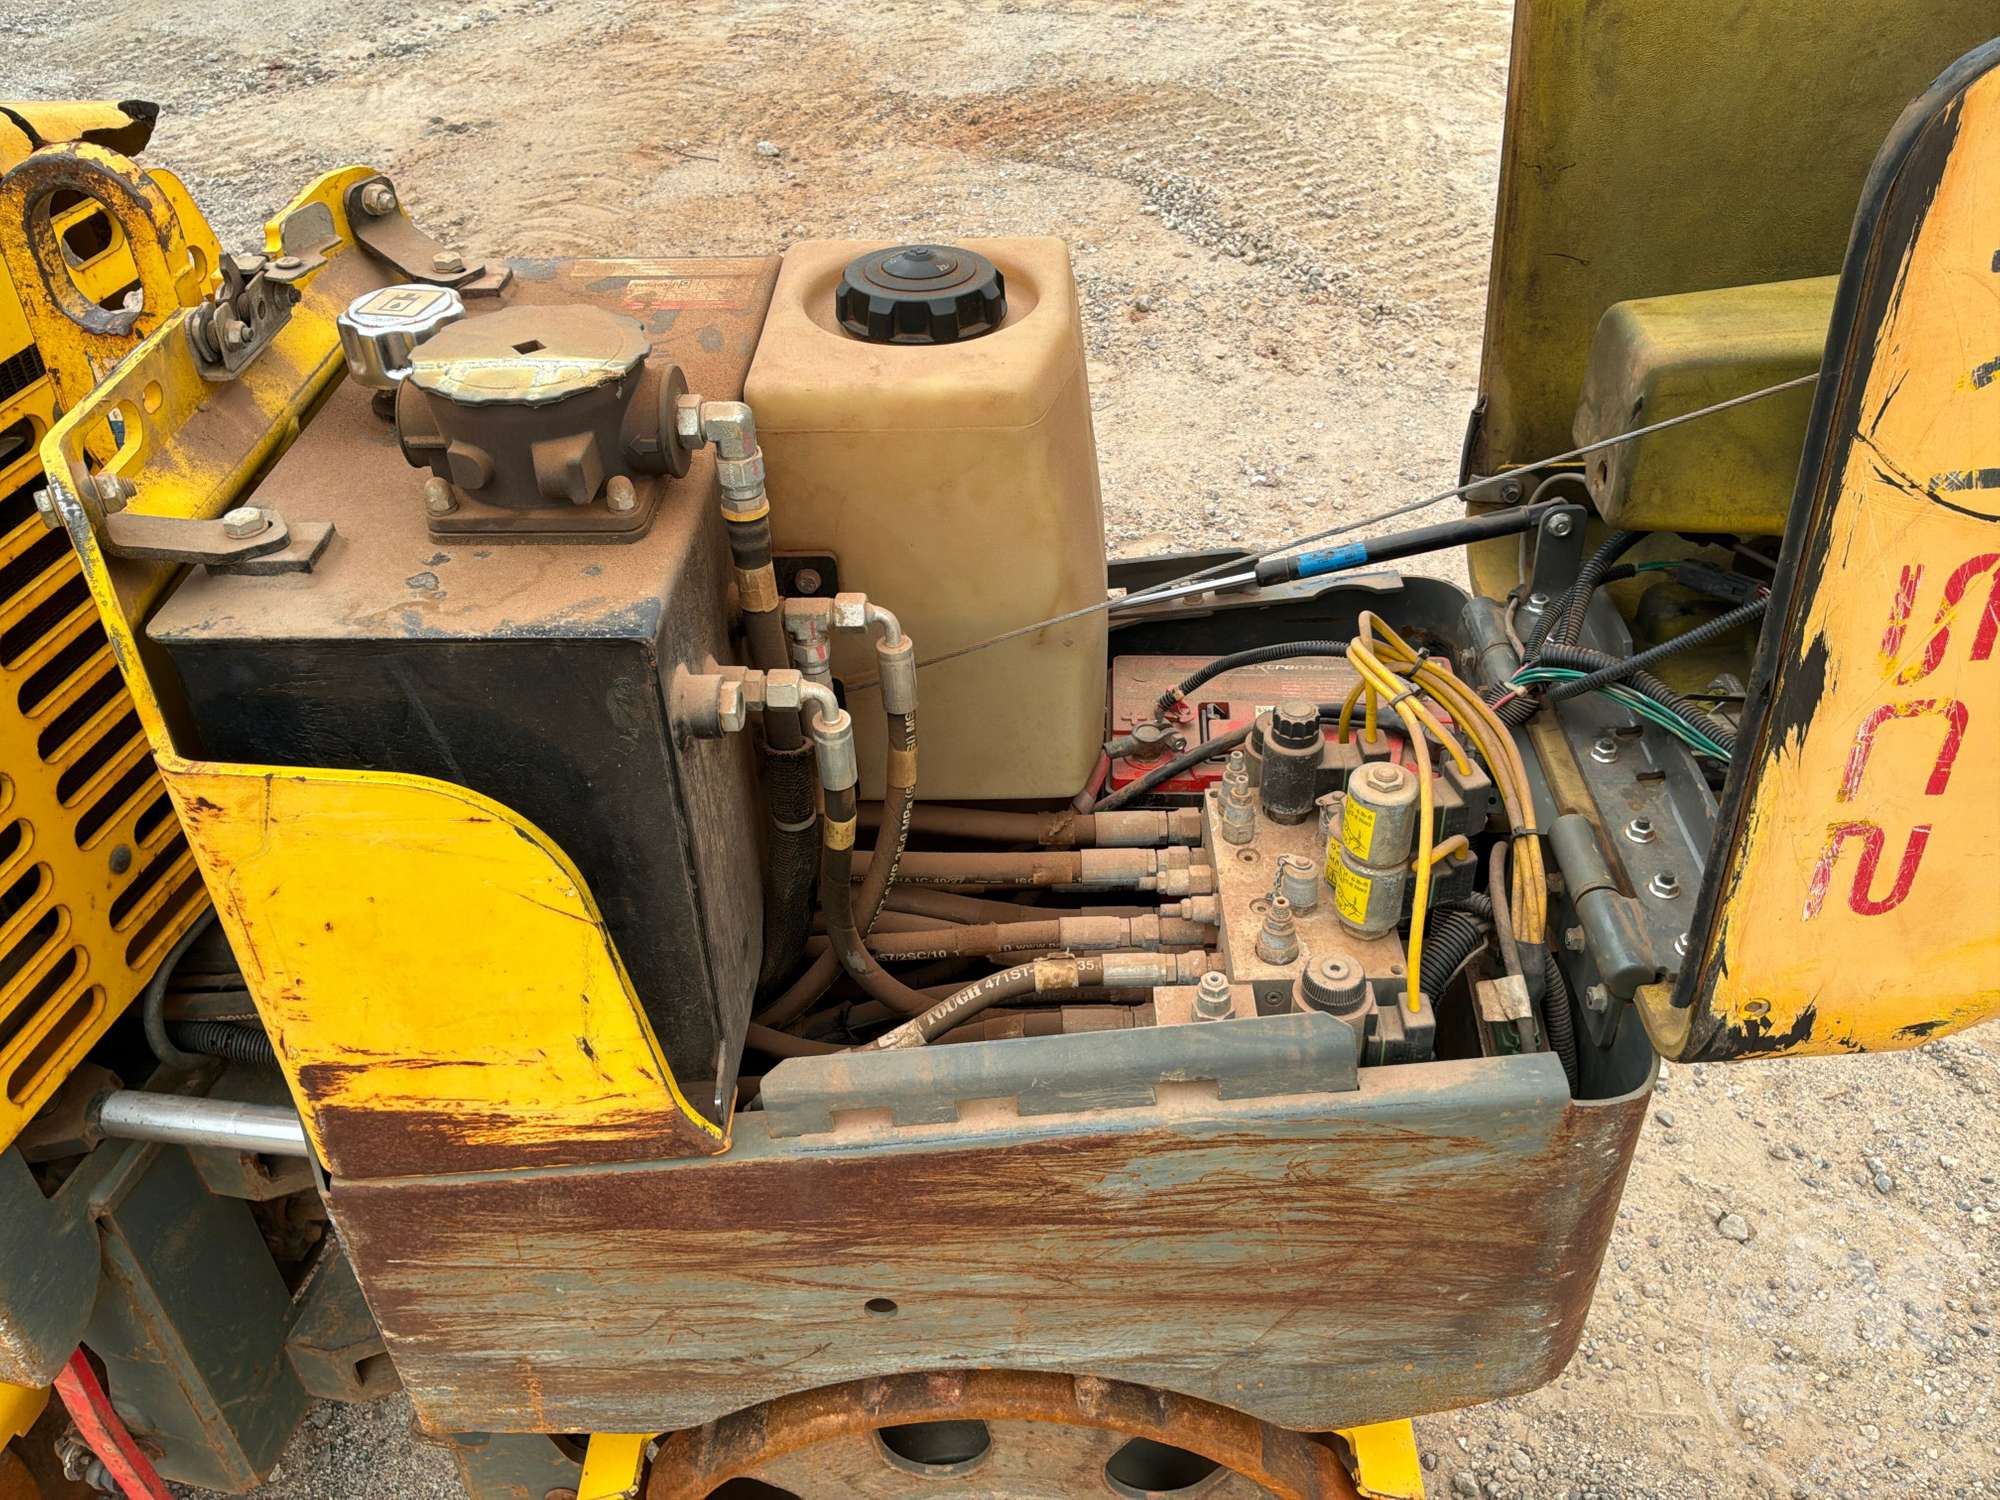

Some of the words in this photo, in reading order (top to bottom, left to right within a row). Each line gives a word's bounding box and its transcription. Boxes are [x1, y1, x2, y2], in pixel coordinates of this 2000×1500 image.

[901, 801, 913, 831] MPa
[880, 949, 947, 961] 57/2SC/10
[926, 983, 983, 1026] TOUGH
[985, 965, 1035, 989] 471ST-
